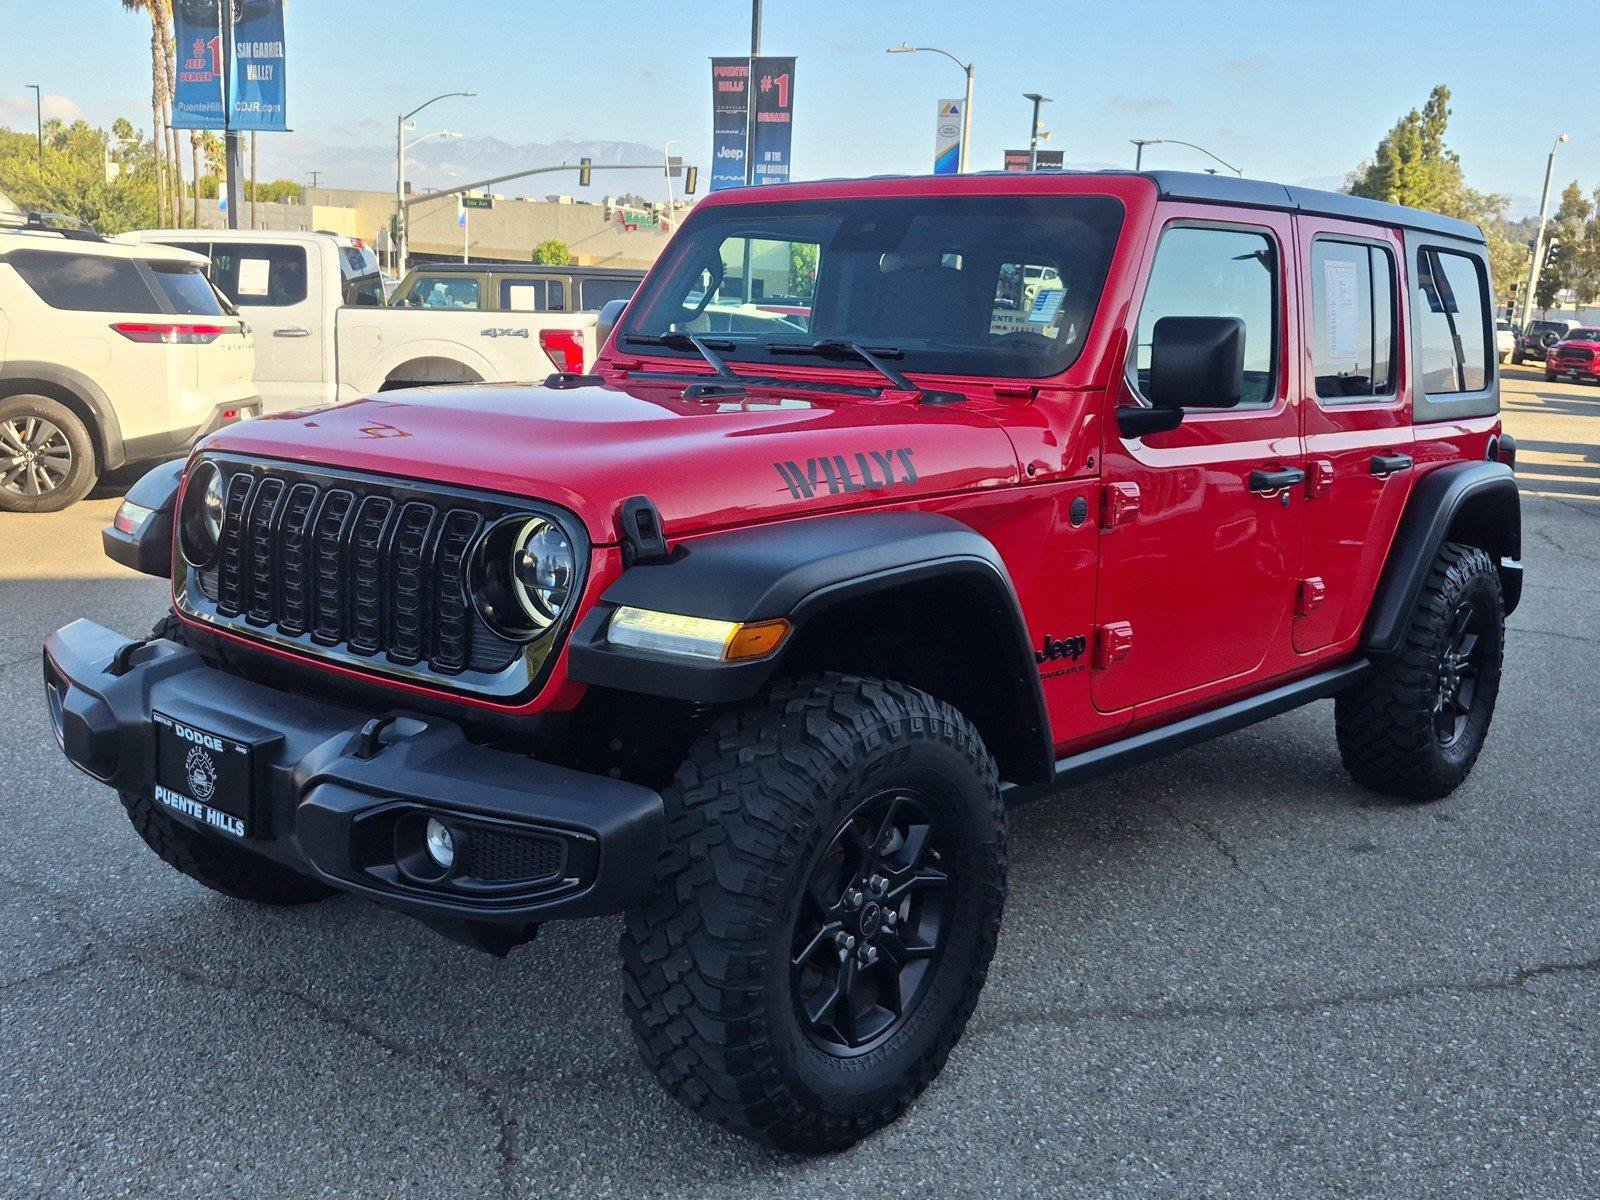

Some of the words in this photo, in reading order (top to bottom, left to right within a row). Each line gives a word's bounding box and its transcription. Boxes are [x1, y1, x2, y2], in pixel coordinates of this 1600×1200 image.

[237, 42, 252, 58] SAN
[253, 41, 283, 58] GABRIEL
[184, 59, 206, 69] JEEP
[246, 64, 273, 80] VALLEY
[719, 80, 744, 92] HILLS
[760, 74, 789, 107] #1
[234, 101, 281, 112] CDJR.com
[717, 146, 744, 160] Jeep
[773, 447, 918, 499] WILLYS
[1034, 634, 1086, 663] Jeep
[175, 723, 224, 752] DODGE
[155, 784, 203, 819] PUENTE
[206, 805, 245, 837] HILLS
